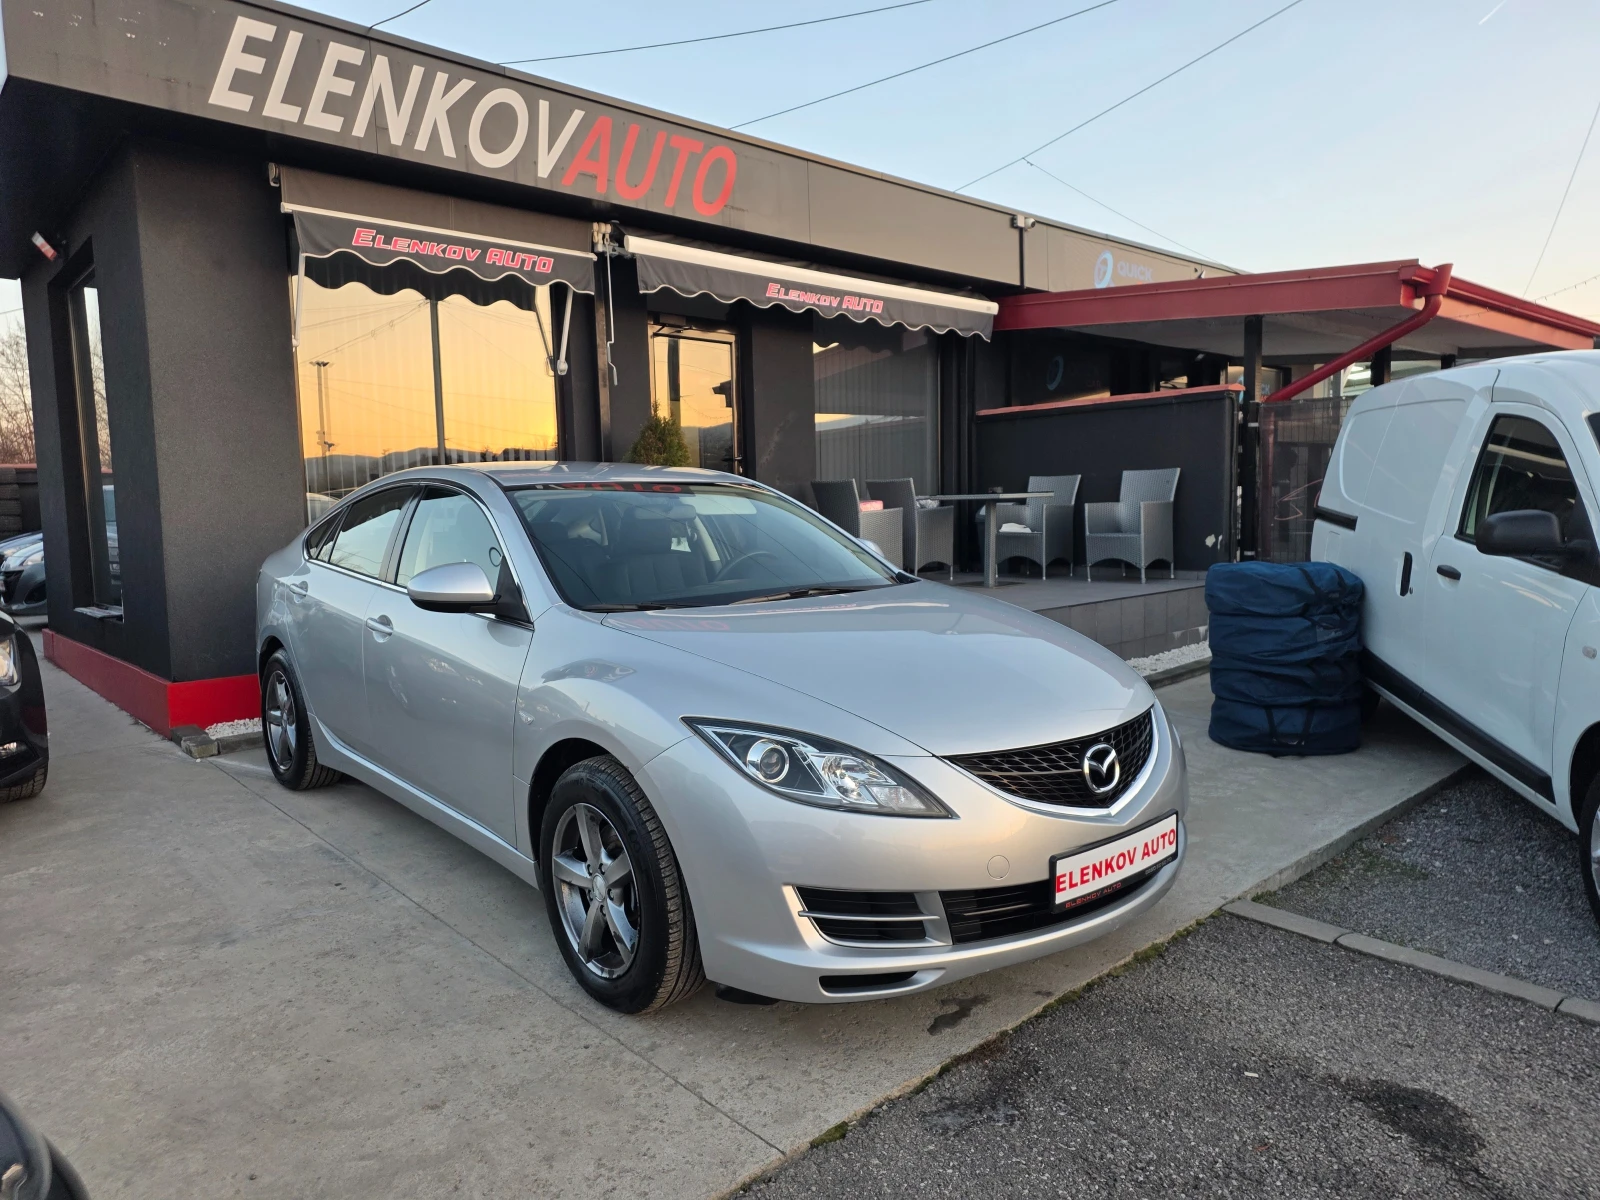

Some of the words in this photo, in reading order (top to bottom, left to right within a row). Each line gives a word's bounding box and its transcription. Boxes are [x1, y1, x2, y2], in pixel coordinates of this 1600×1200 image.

[352, 227, 481, 262] ELENKOV
[485, 247, 554, 273] AUTO
[1117, 261, 1153, 281] QUICK
[766, 282, 840, 307] ELENKOV
[842, 295, 884, 314] AUTO
[1056, 847, 1137, 893] ELENKOV
[1141, 828, 1176, 860] AUTO
